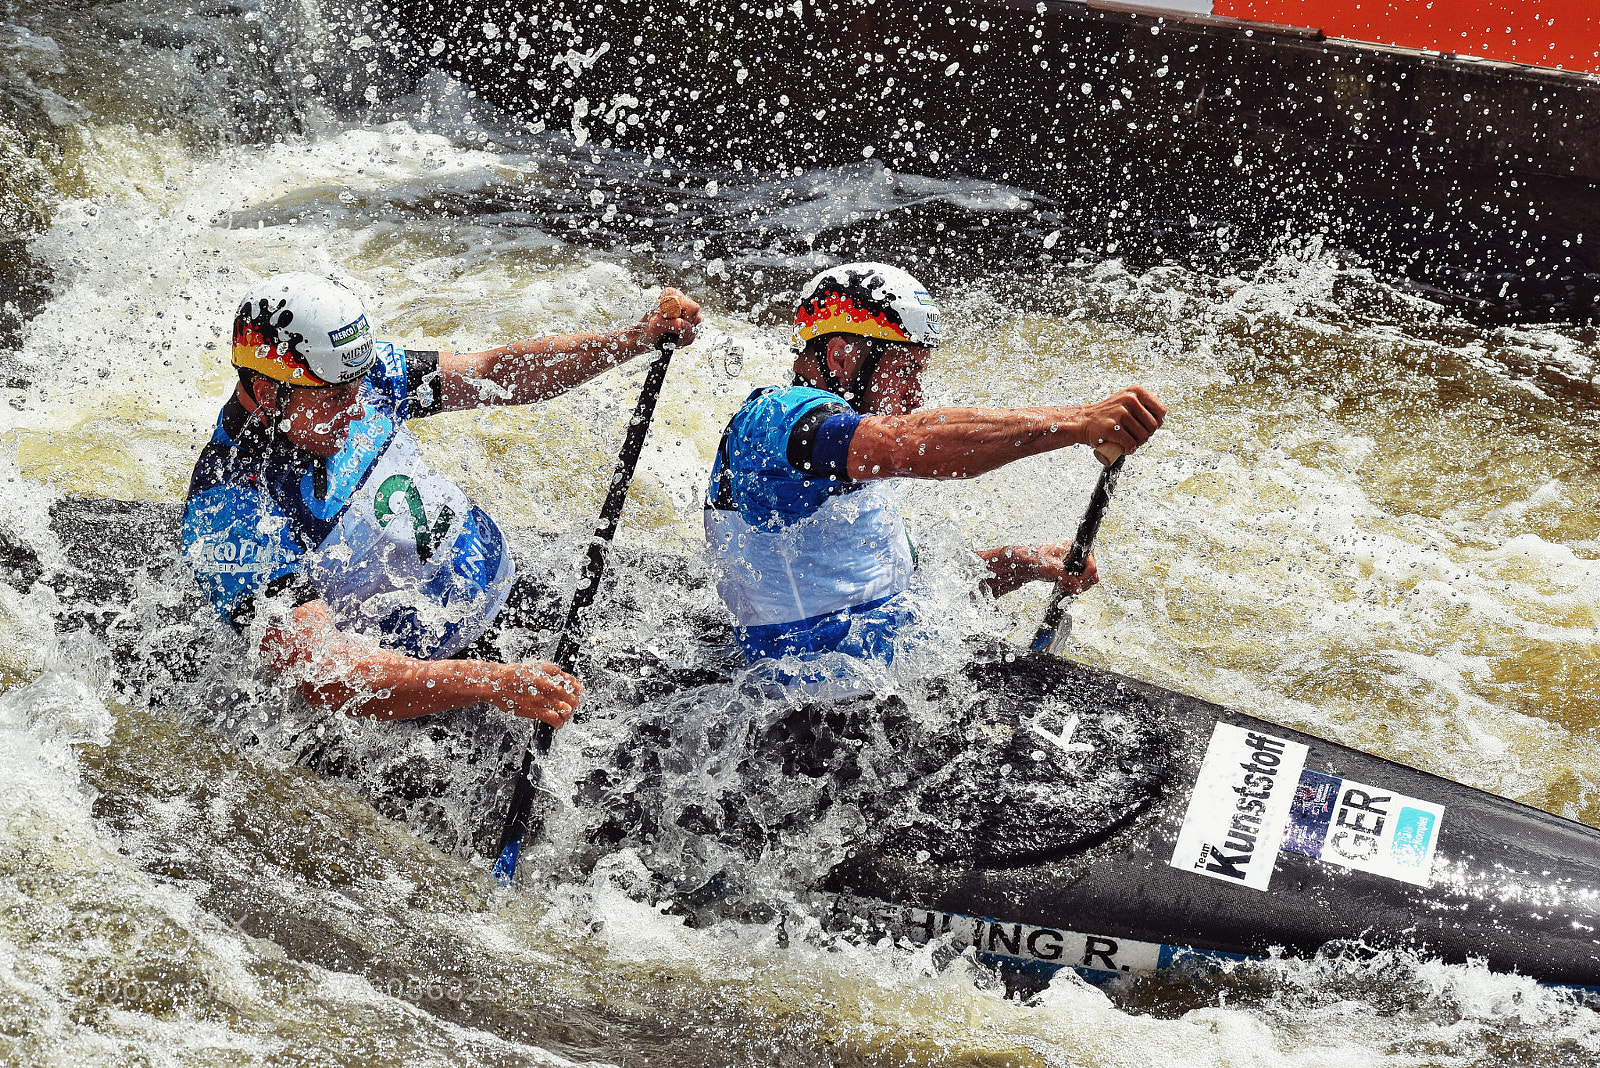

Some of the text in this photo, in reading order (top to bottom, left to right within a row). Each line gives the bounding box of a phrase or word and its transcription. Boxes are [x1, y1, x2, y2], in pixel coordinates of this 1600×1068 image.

[331, 326, 355, 342] MERCO
[374, 473, 456, 566] 2
[1205, 731, 1286, 880] Kunststoff
[1331, 788, 1392, 861] GER
[1194, 842, 1211, 869] Team
[1083, 935, 1131, 972] R.
